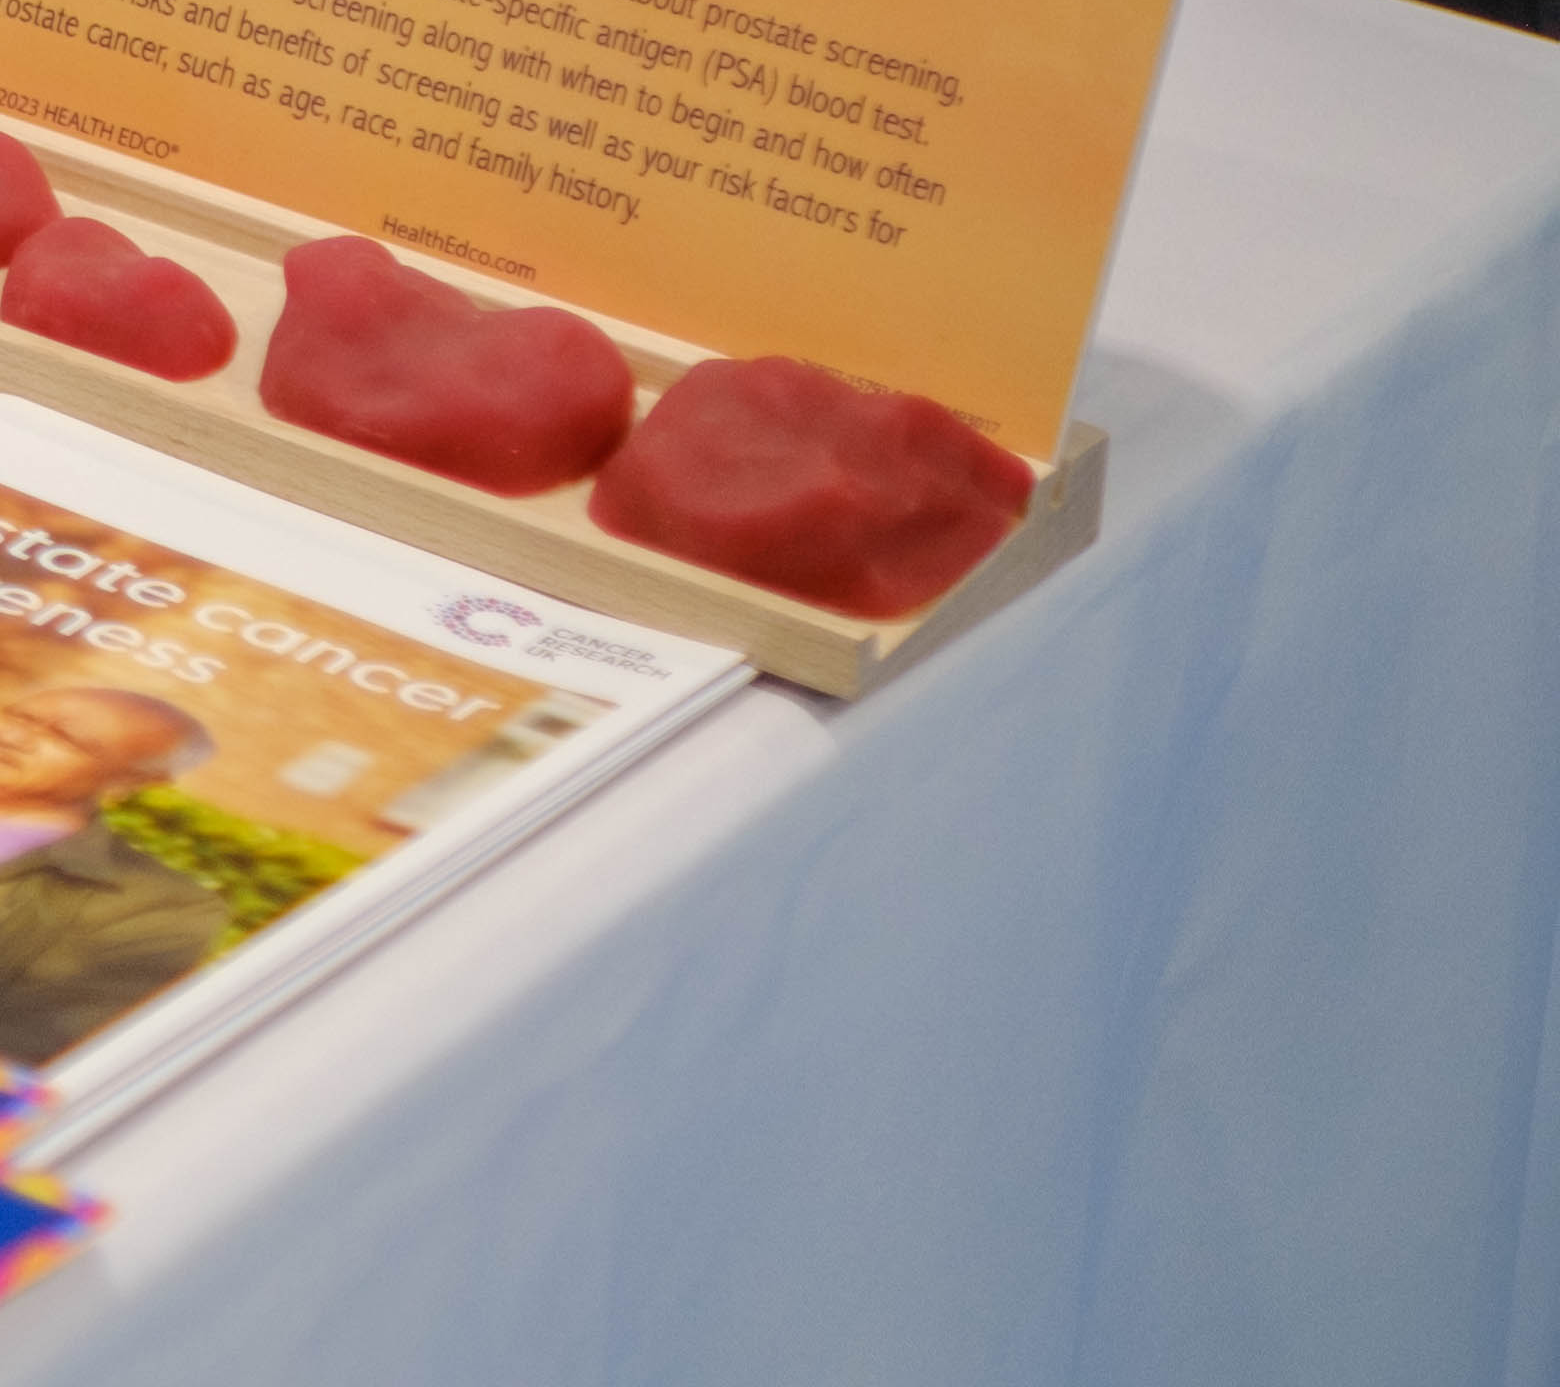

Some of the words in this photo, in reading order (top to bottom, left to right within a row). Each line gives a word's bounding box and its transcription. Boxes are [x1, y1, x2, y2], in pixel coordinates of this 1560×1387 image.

[595, 24, 693, 72] antigen
[702, 49, 779, 106] (PSA)
[787, 74, 867, 125] blood
[872, 103, 929, 146] test.
[701, 3, 818, 56] prostate
[823, 39, 964, 108] screening,
[43, 102, 115, 142] HEALTH
[183, 1, 233, 34] and
[236, 8, 335, 67] benefits
[341, 47, 372, 77] of
[375, 63, 502, 129] screening
[506, 104, 539, 132] as
[548, 116, 599, 150] well
[602, 134, 634, 163] as
[637, 146, 704, 182] your
[708, 164, 758, 201] risk
[765, 176, 859, 234] factors
[867, 209, 908, 247] for
[421, 20, 494, 72] along
[501, 45, 552, 82] with
[560, 64, 628, 106] when
[635, 85, 663, 117] to
[669, 92, 745, 144] begin
[751, 127, 808, 161] and
[812, 137, 869, 181] how
[875, 162, 946, 205] often
[380, 213, 538, 284] HealthEdco.com
[188, 593, 503, 722] cancer
[524, 645, 558, 663] UK
[537, 636, 672, 681] RESEARCH
[552, 627, 657, 663] CANCER
